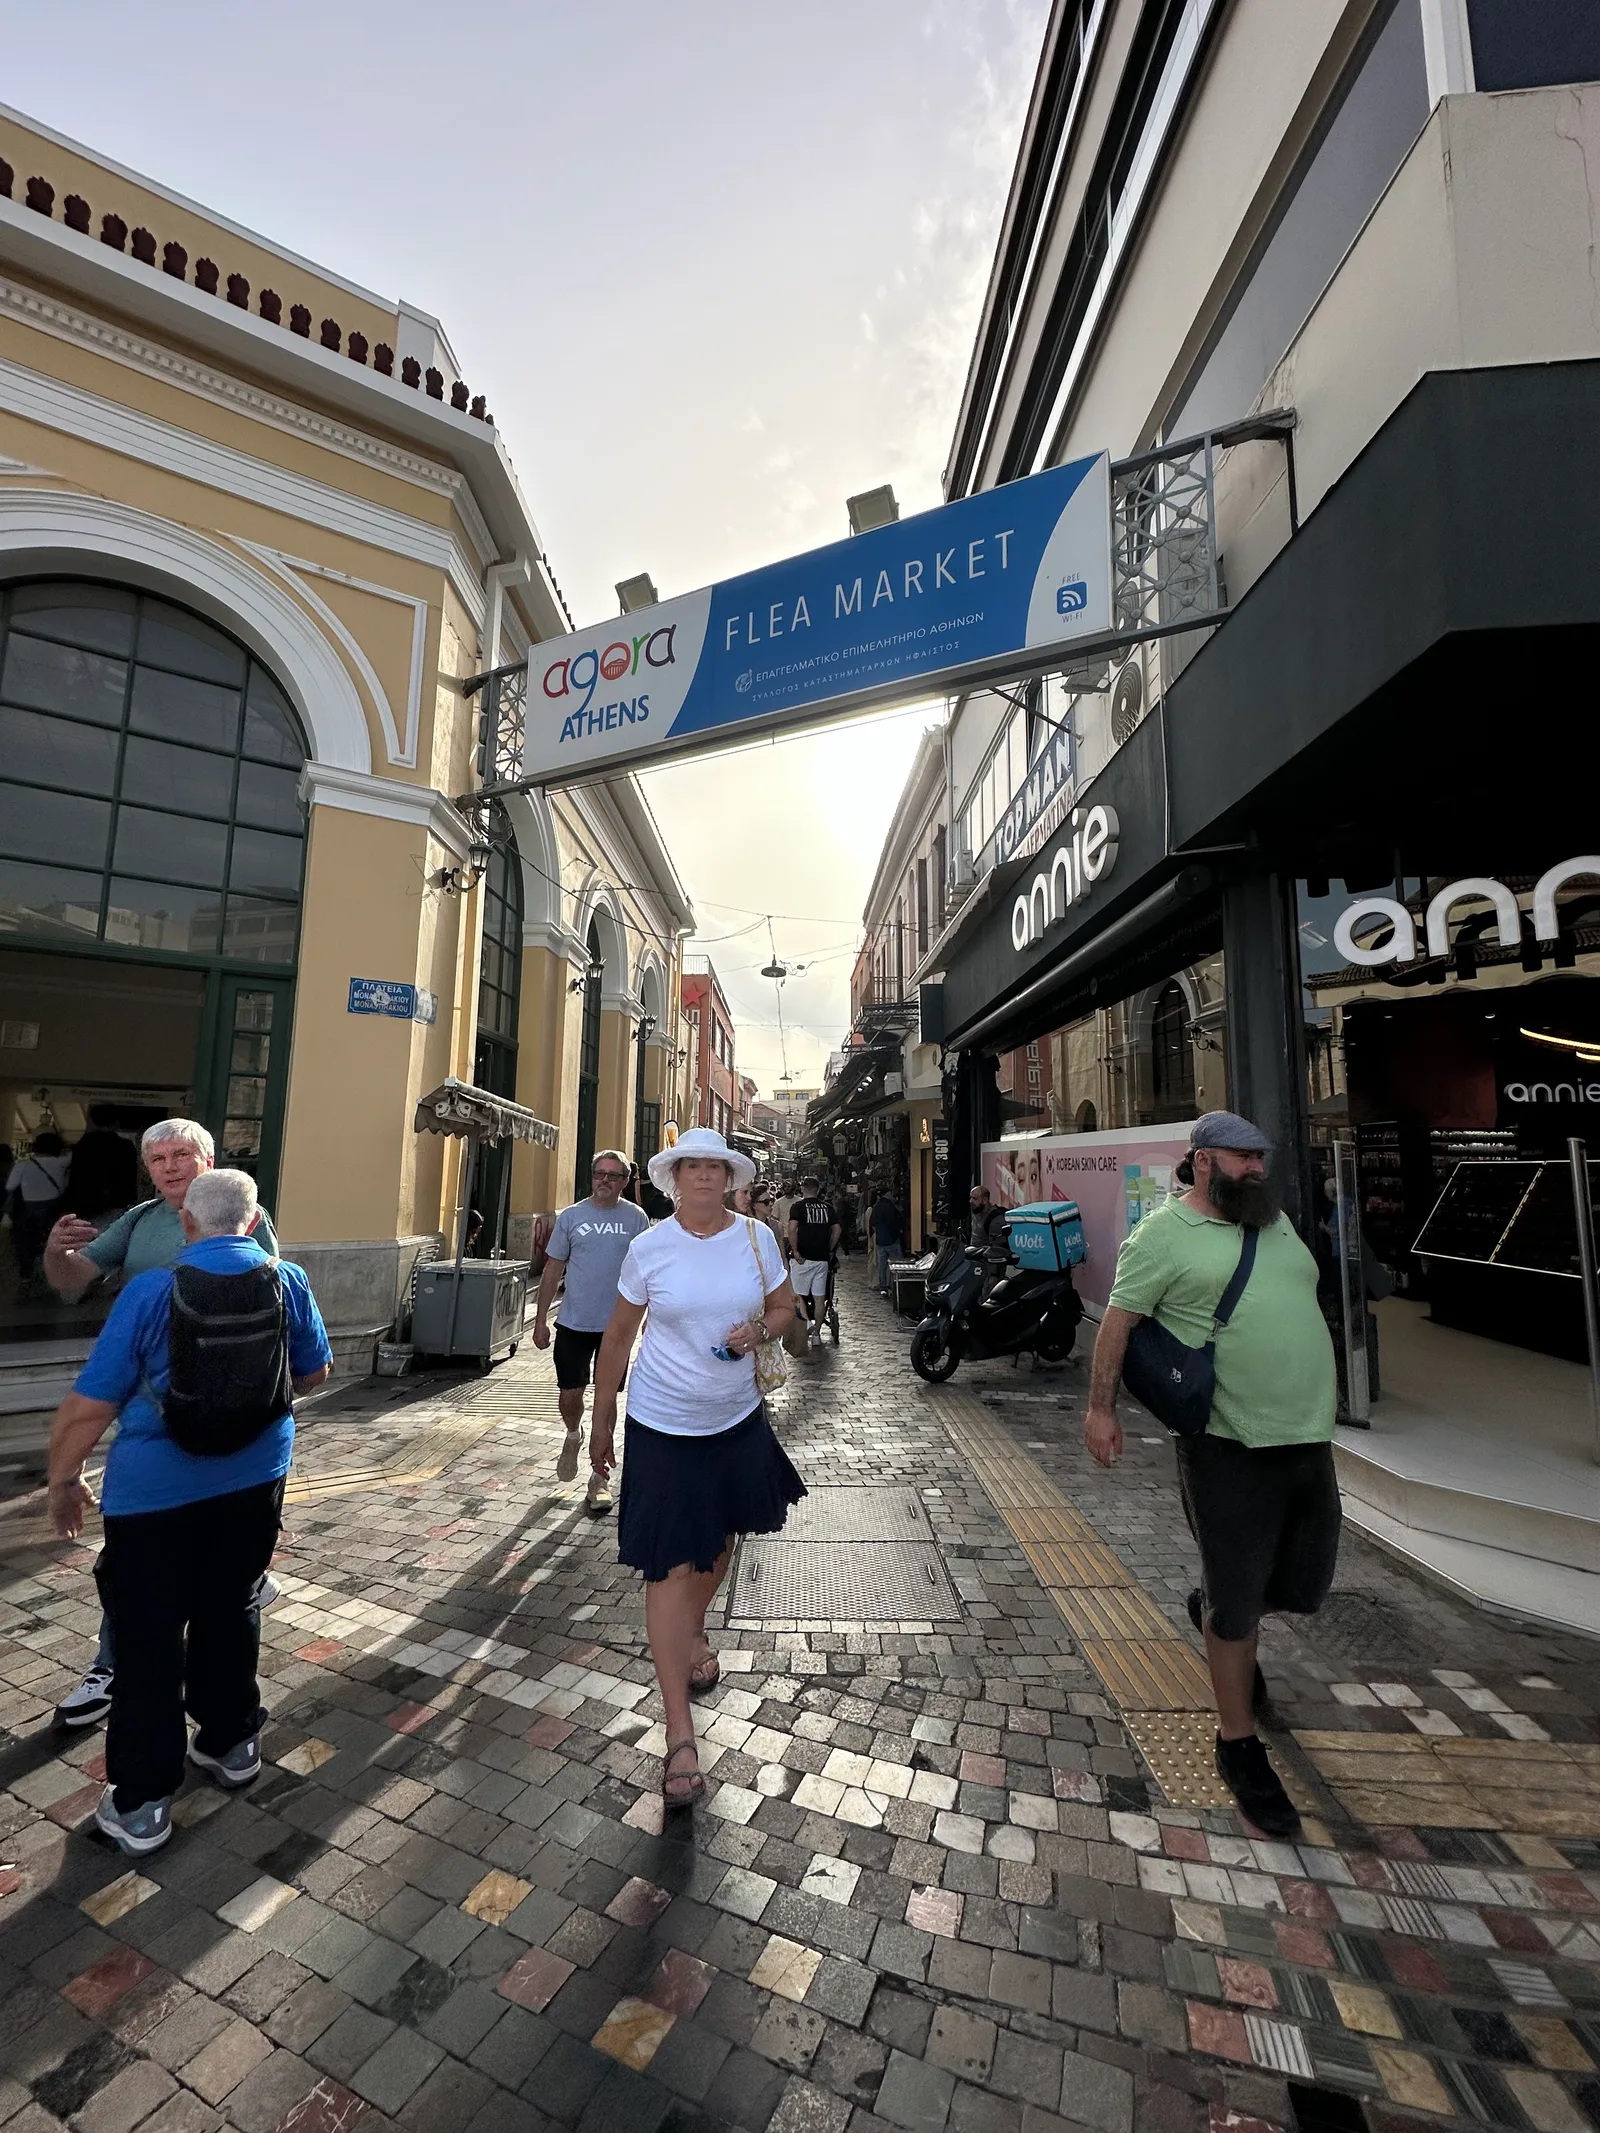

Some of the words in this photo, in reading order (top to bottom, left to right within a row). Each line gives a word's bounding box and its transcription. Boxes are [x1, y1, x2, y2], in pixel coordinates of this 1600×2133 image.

[1062, 572, 1081, 584] FREE
[726, 596, 811, 651] FLEA
[835, 529, 1015, 619] MARKET
[1061, 611, 1083, 623] WI-FI
[756, 651, 840, 682] ΕΠΑΓΓΕΛΜΑΤΙΚΟ
[842, 628, 926, 659] ΕΠΙΜΕΛΗΤΗΡΙΟ
[929, 612, 985, 635] ΑΘΗΝΩΝ
[543, 623, 677, 719] agora
[752, 684, 799, 702] ΣΥΛΛΟΓΟΣ
[803, 656, 900, 688] ΚΑΤΑΣΤΗΜΑΤΑΡΧΩΝ
[905, 641, 960, 662] ΗΦΑΙΣΤΟΣ
[559, 695, 650, 743] ATHENS
[1012, 805, 1120, 952] annie
[362, 982, 403, 994] ΠΛΑΤΕΙΑ
[1507, 1077, 1600, 1103] annie
[1056, 1157, 1080, 1171] KOREAN
[1081, 1157, 1097, 1171] SKIN
[1098, 1156, 1117, 1171] CARE
[593, 1222, 627, 1235] VAIL
[1014, 1234, 1045, 1249] Wolt
[1064, 1231, 1082, 1248] Wolt
